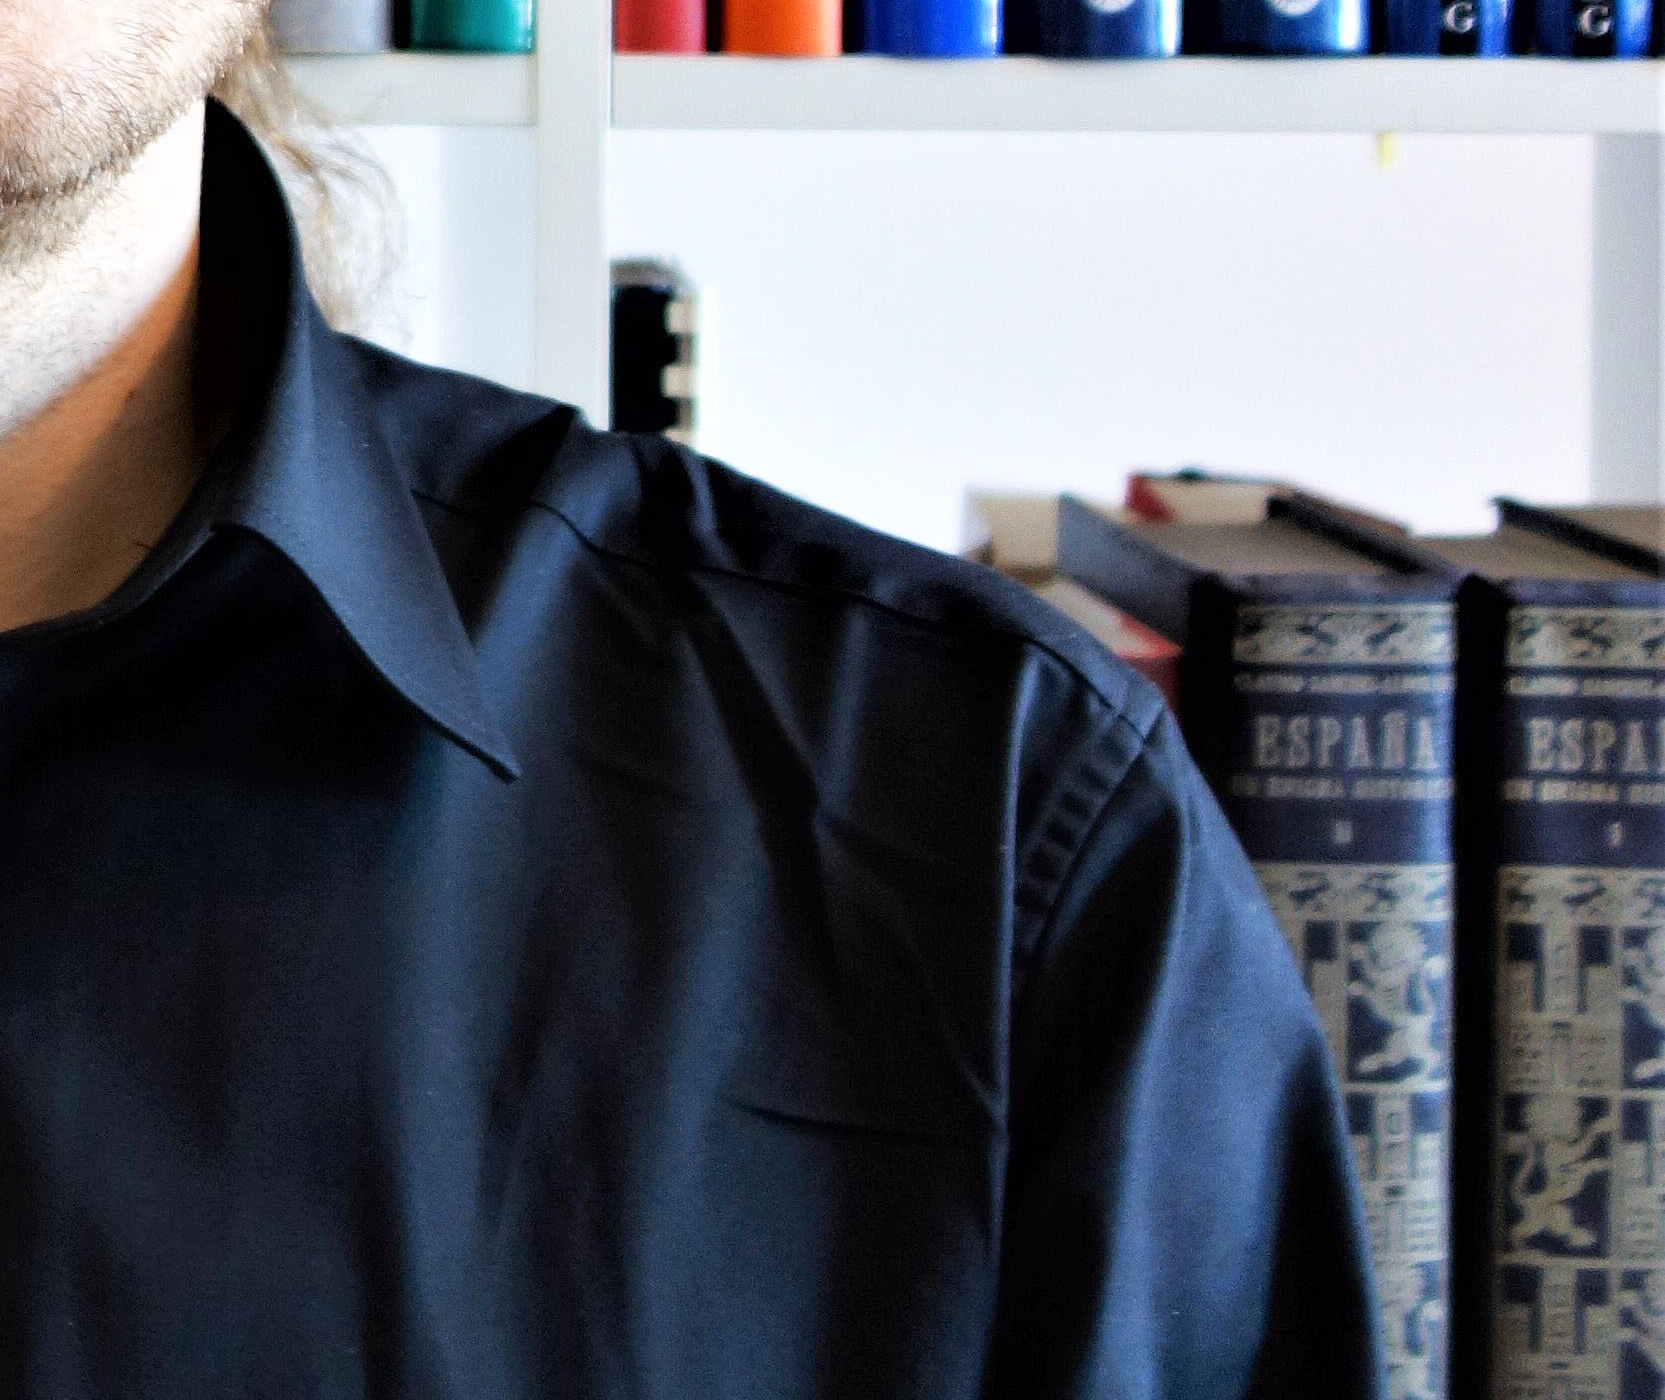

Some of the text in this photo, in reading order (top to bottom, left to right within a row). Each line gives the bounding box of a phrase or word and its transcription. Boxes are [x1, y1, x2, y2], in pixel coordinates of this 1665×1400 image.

[1445, 1, 1475, 34] G
[1579, 5, 1612, 38] G
[1254, 711, 1441, 769] ESPAÑA
